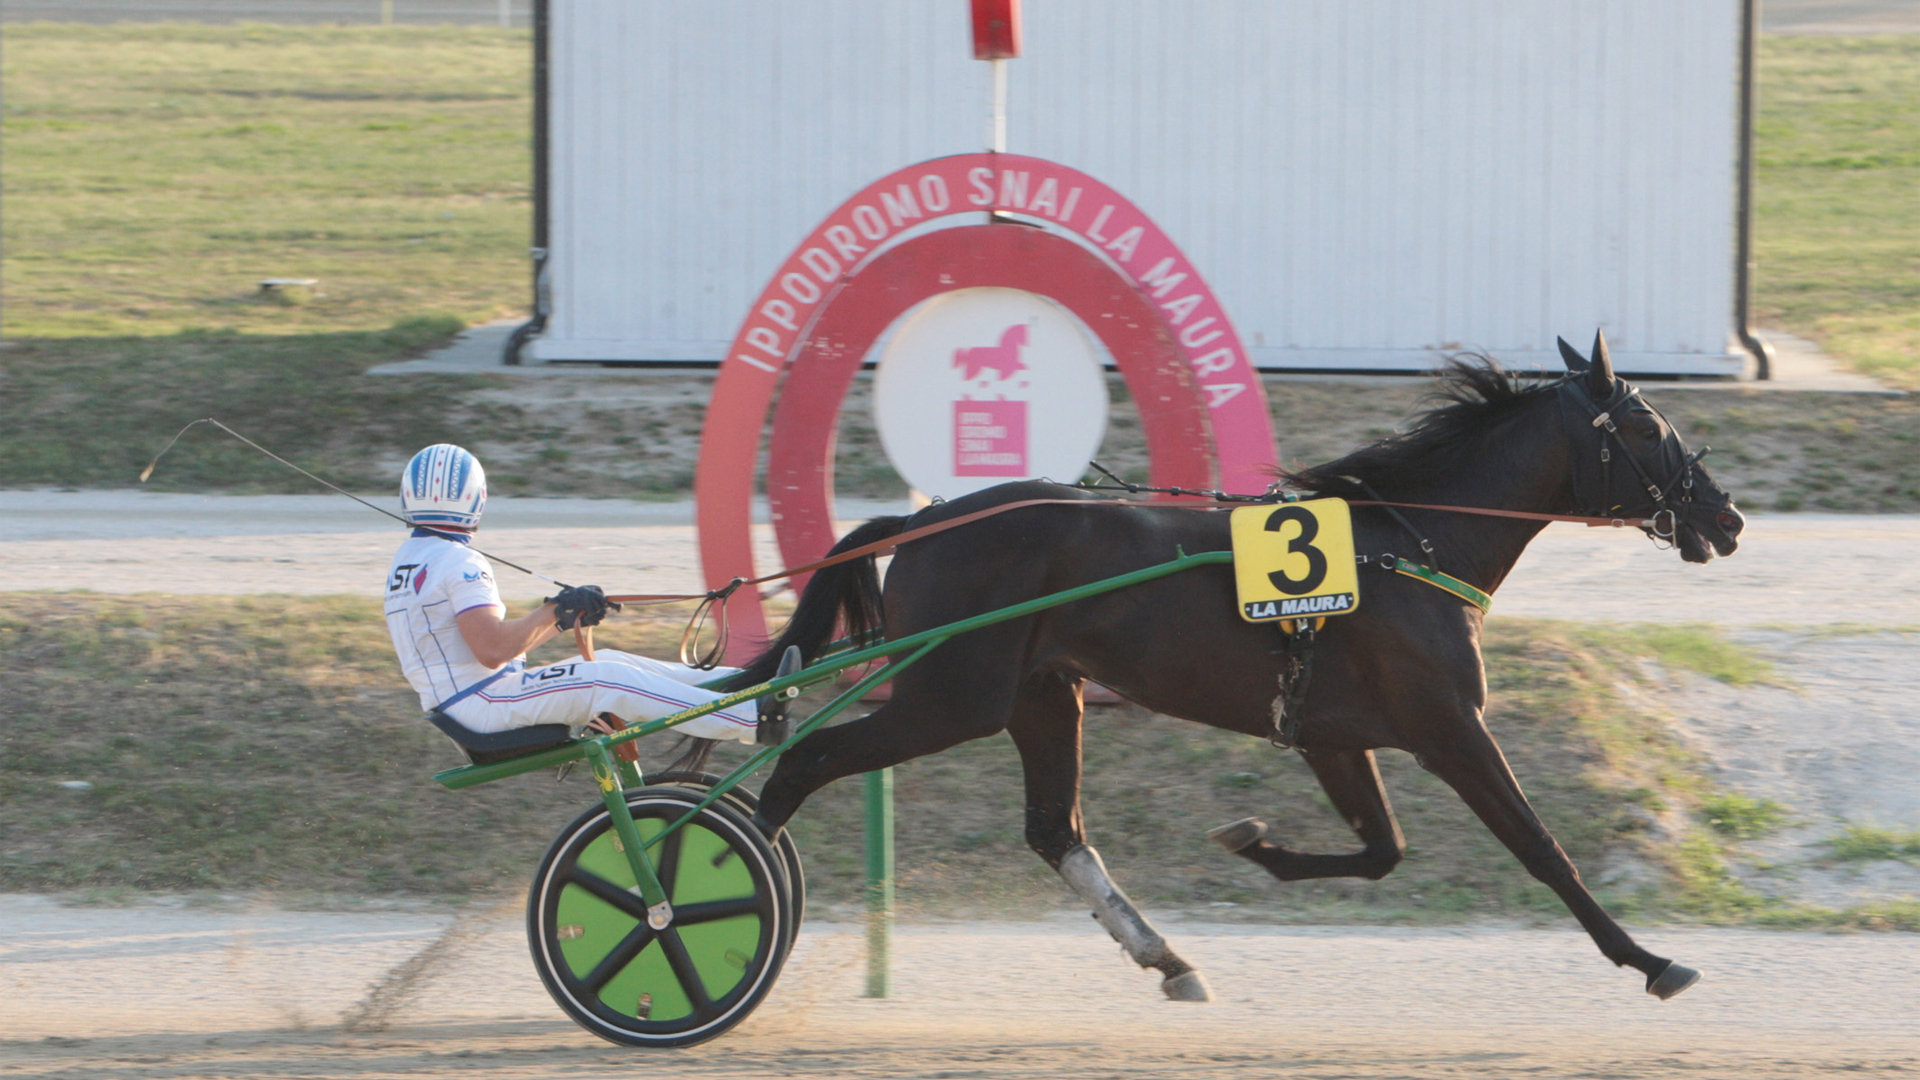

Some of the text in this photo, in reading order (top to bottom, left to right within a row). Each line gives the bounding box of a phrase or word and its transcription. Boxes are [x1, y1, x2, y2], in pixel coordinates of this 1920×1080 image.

[737, 166, 1248, 408] IPPODROMO SNAI LA MAURA
[1263, 505, 1328, 596] 3
[1251, 595, 1348, 618] LA MAURA
[521, 662, 583, 685] MST
